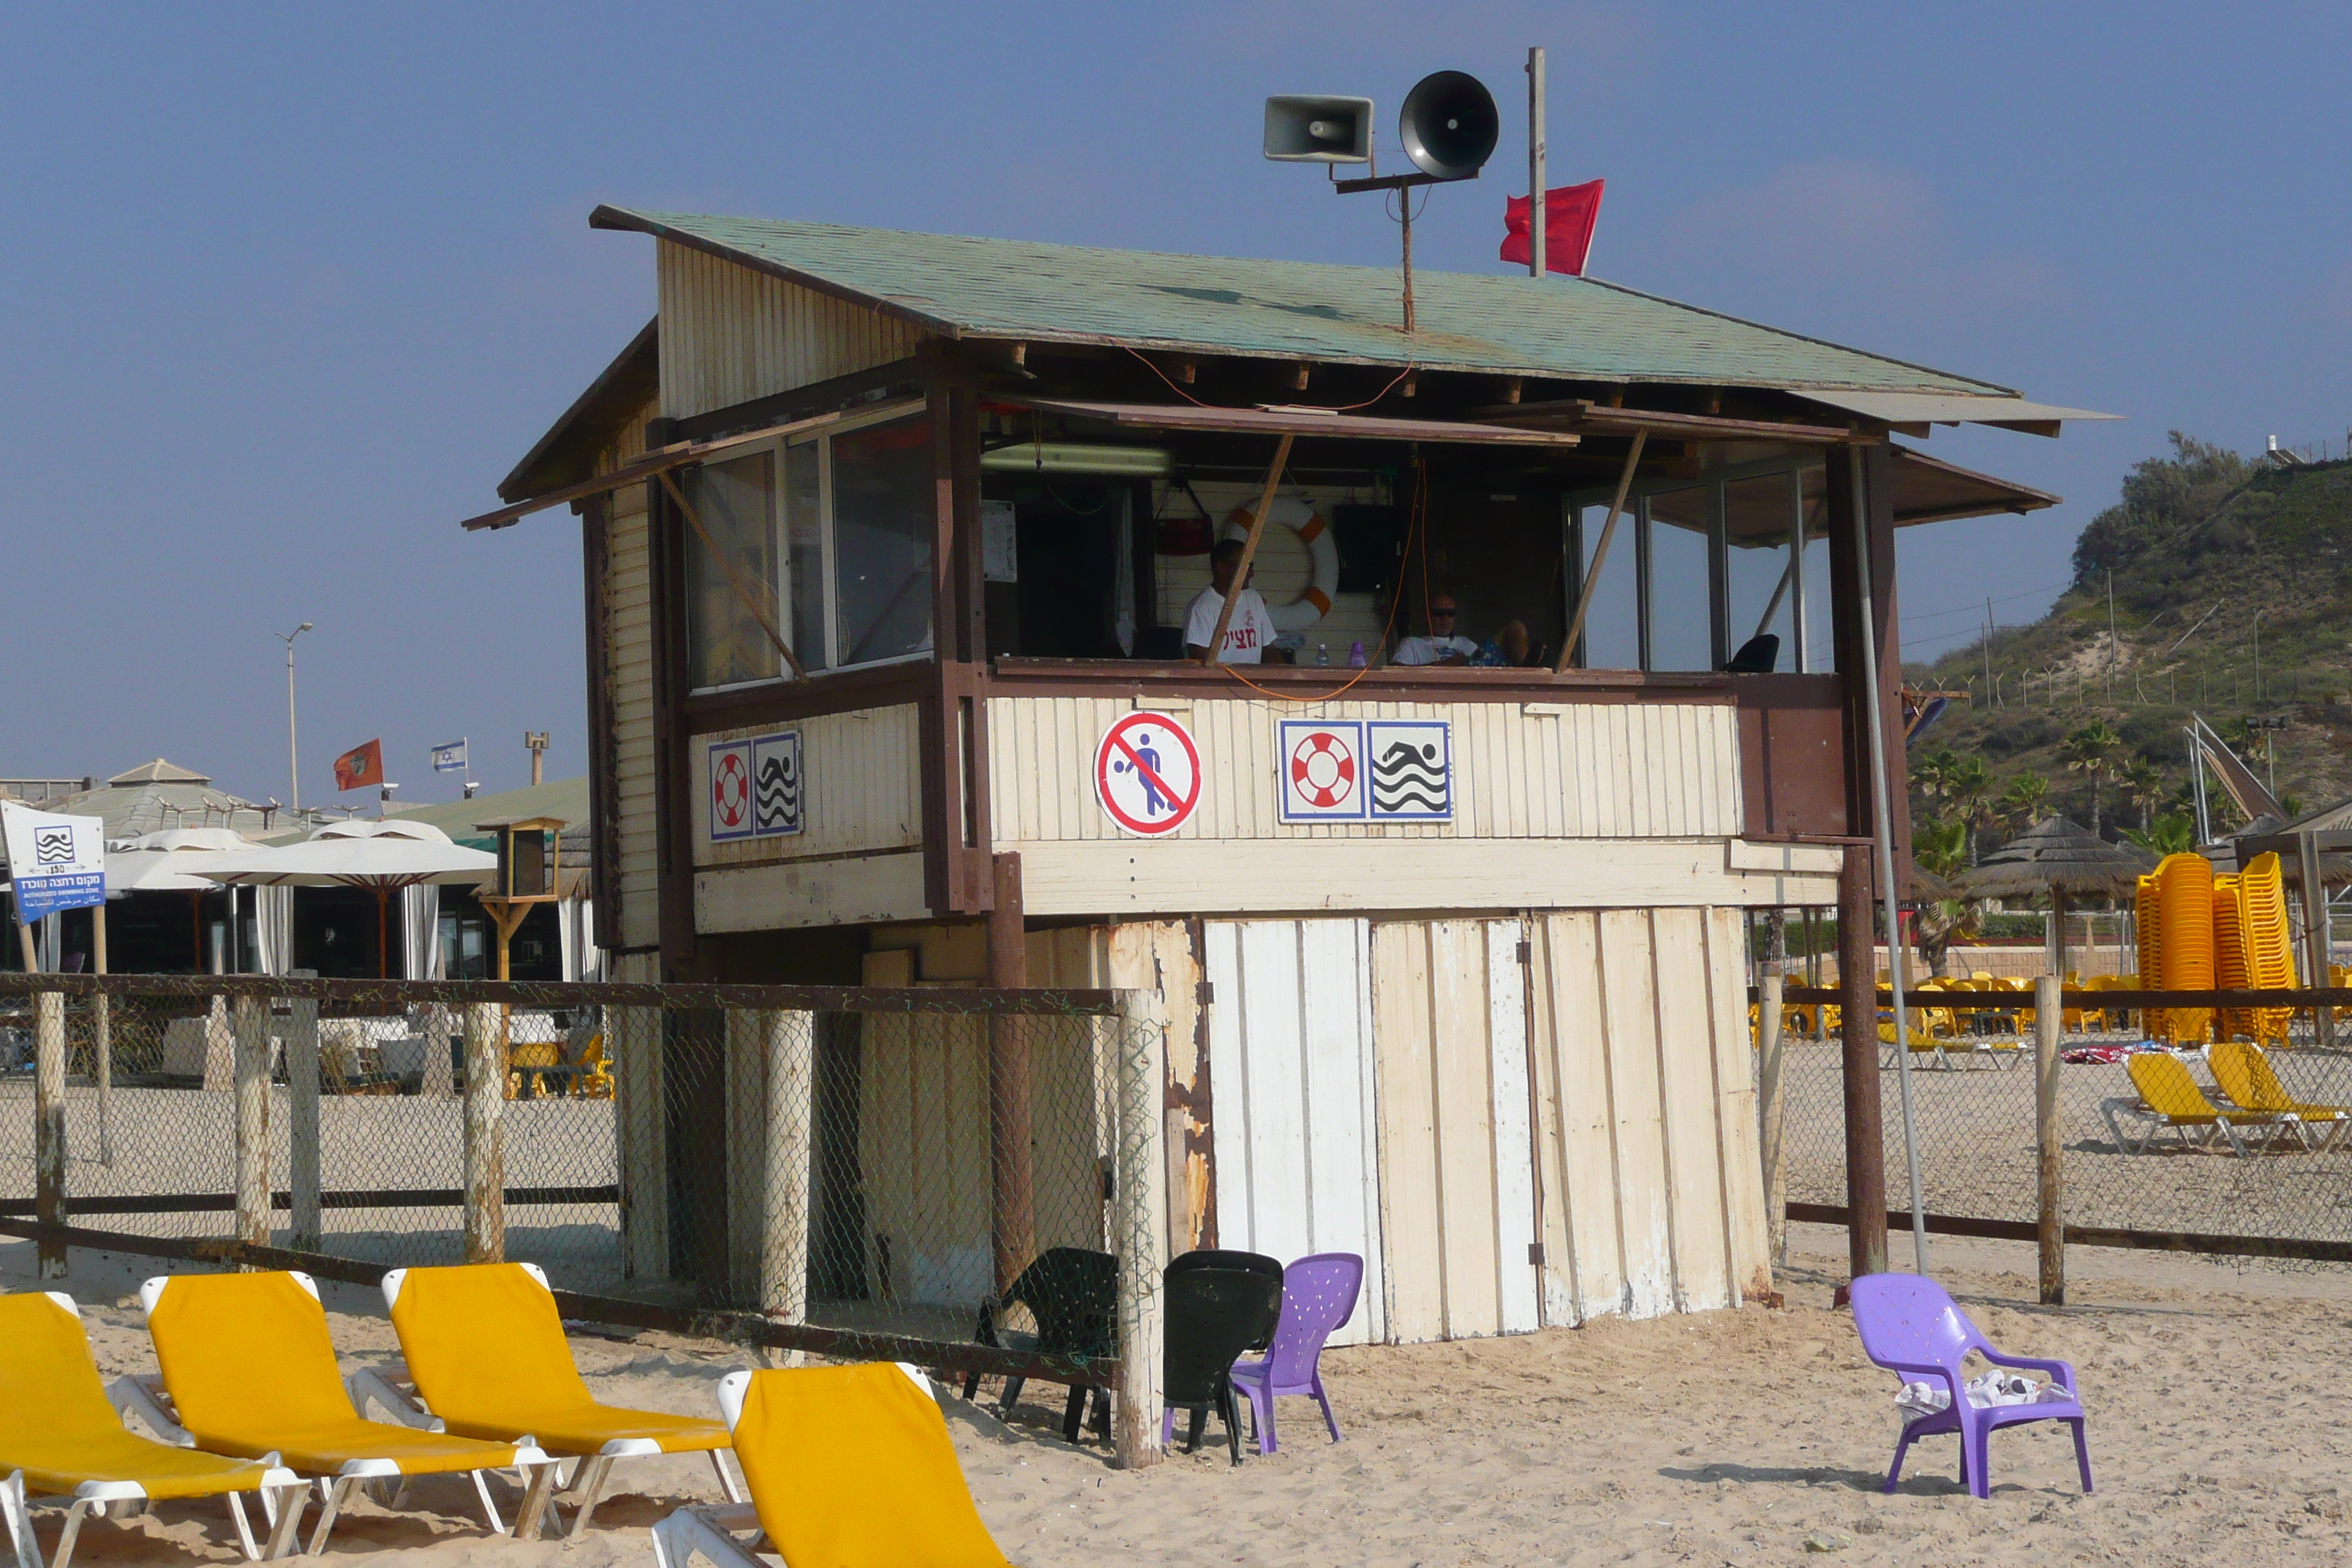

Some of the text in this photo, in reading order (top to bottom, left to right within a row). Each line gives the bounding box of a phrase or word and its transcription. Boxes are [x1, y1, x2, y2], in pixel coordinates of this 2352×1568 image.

[50, 864, 65, 874] 150
[20, 875, 100, 889] מקום רחצה מוכרז
[23, 890, 56, 898] AUTHORIZED
[58, 888, 85, 896] SWIMMING
[83, 895, 100, 904] مكان
